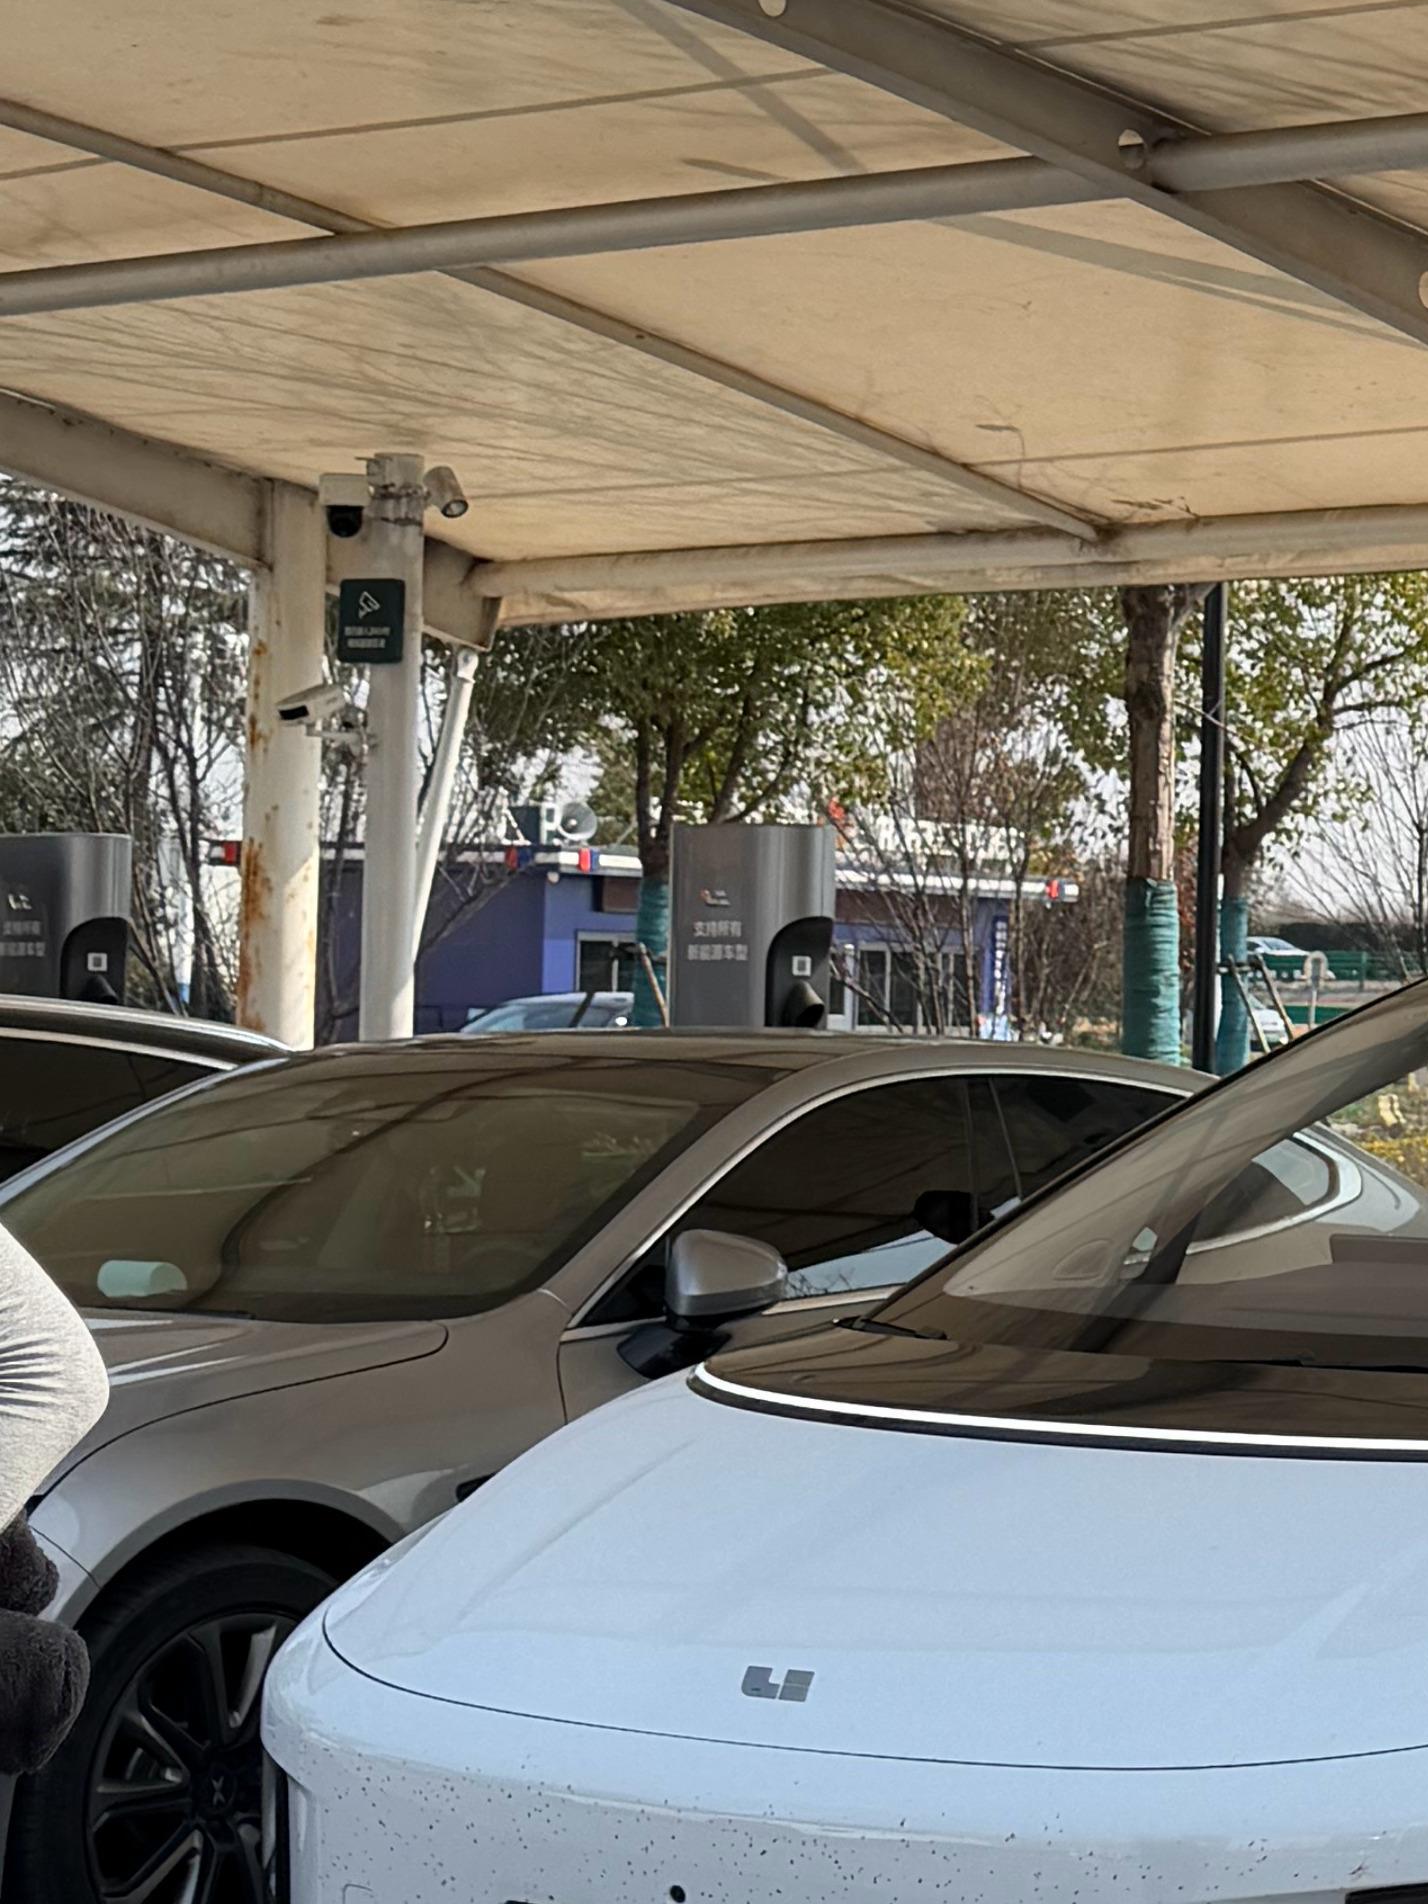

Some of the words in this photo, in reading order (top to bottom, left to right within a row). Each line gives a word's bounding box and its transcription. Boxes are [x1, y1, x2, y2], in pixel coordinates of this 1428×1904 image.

[693, 920, 742, 937] 支持所有
[687, 944, 748, 961] 新能源车型
